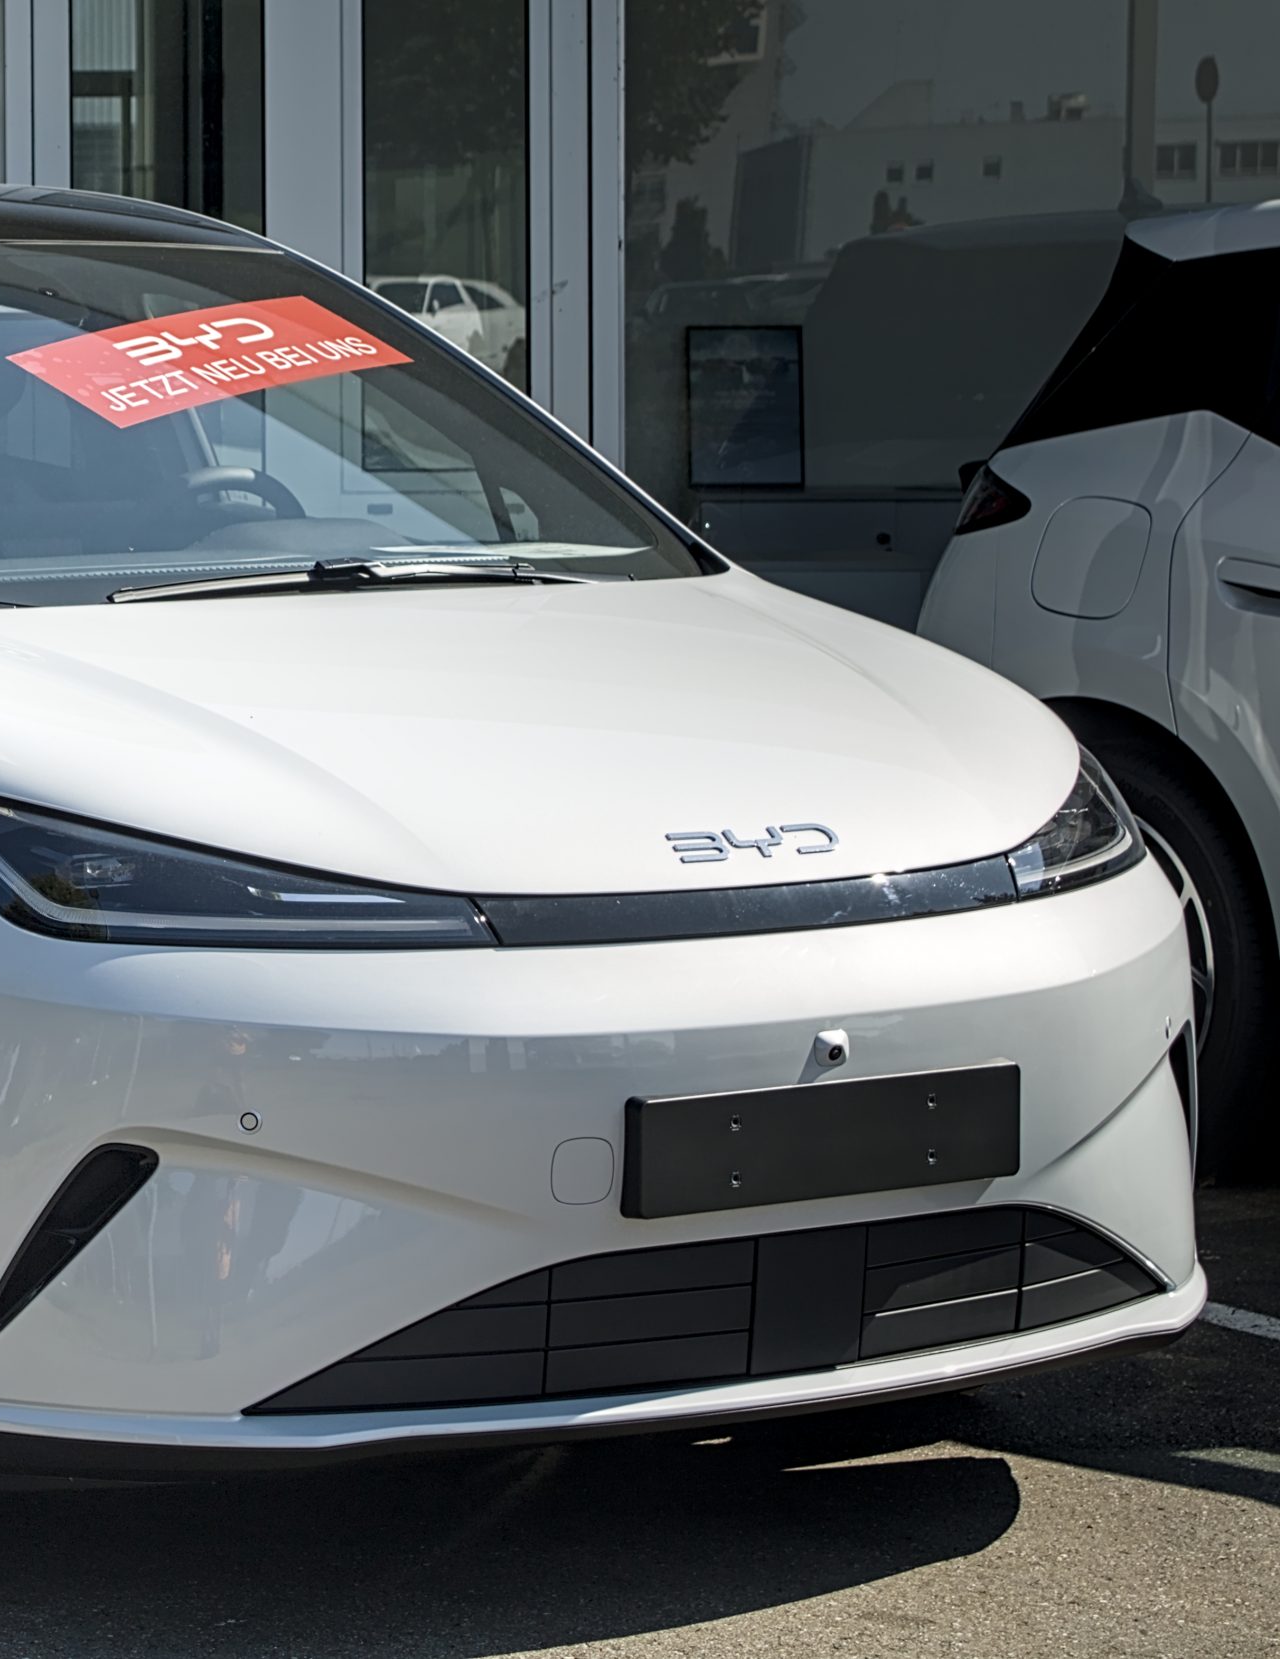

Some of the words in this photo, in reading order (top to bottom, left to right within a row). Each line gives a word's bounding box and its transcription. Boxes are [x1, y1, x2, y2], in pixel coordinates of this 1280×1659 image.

[112, 317, 274, 367] BYD
[101, 369, 199, 412] JETZT
[190, 354, 266, 385] NEU
[256, 342, 318, 370] BEI
[311, 336, 378, 361] UNS
[665, 822, 840, 864] BYD
